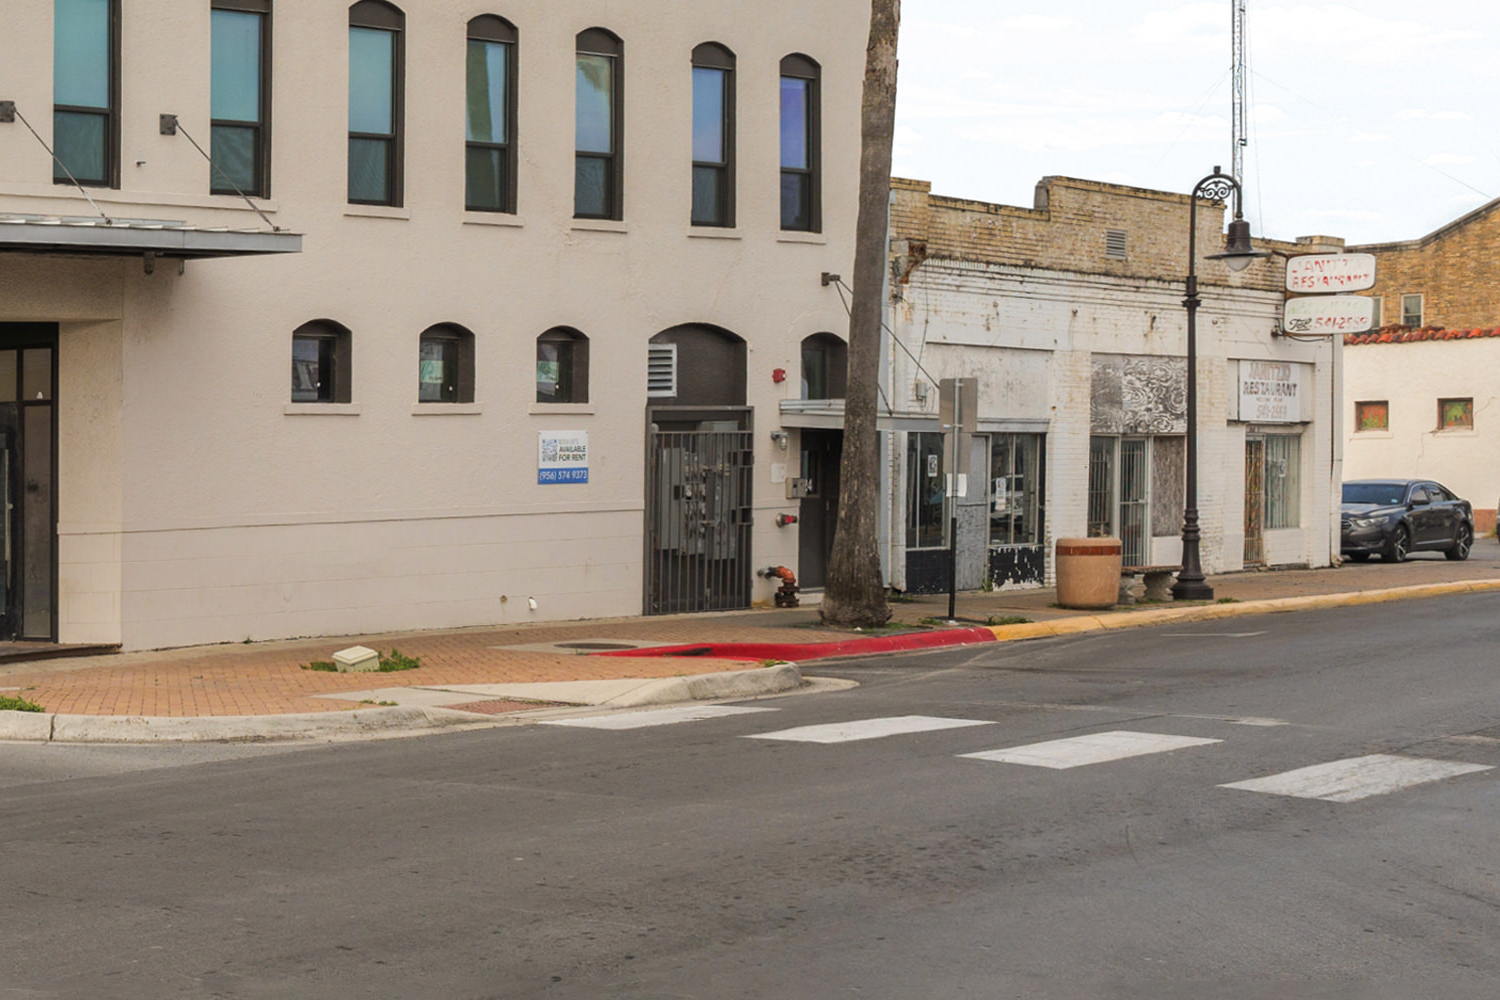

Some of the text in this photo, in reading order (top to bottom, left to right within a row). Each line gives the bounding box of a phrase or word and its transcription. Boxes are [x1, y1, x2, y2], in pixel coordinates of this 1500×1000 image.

[1243, 381, 1297, 397] RESTAURANT
[572, 453, 586, 461] RENT
[540, 471, 557, 480] (956)
